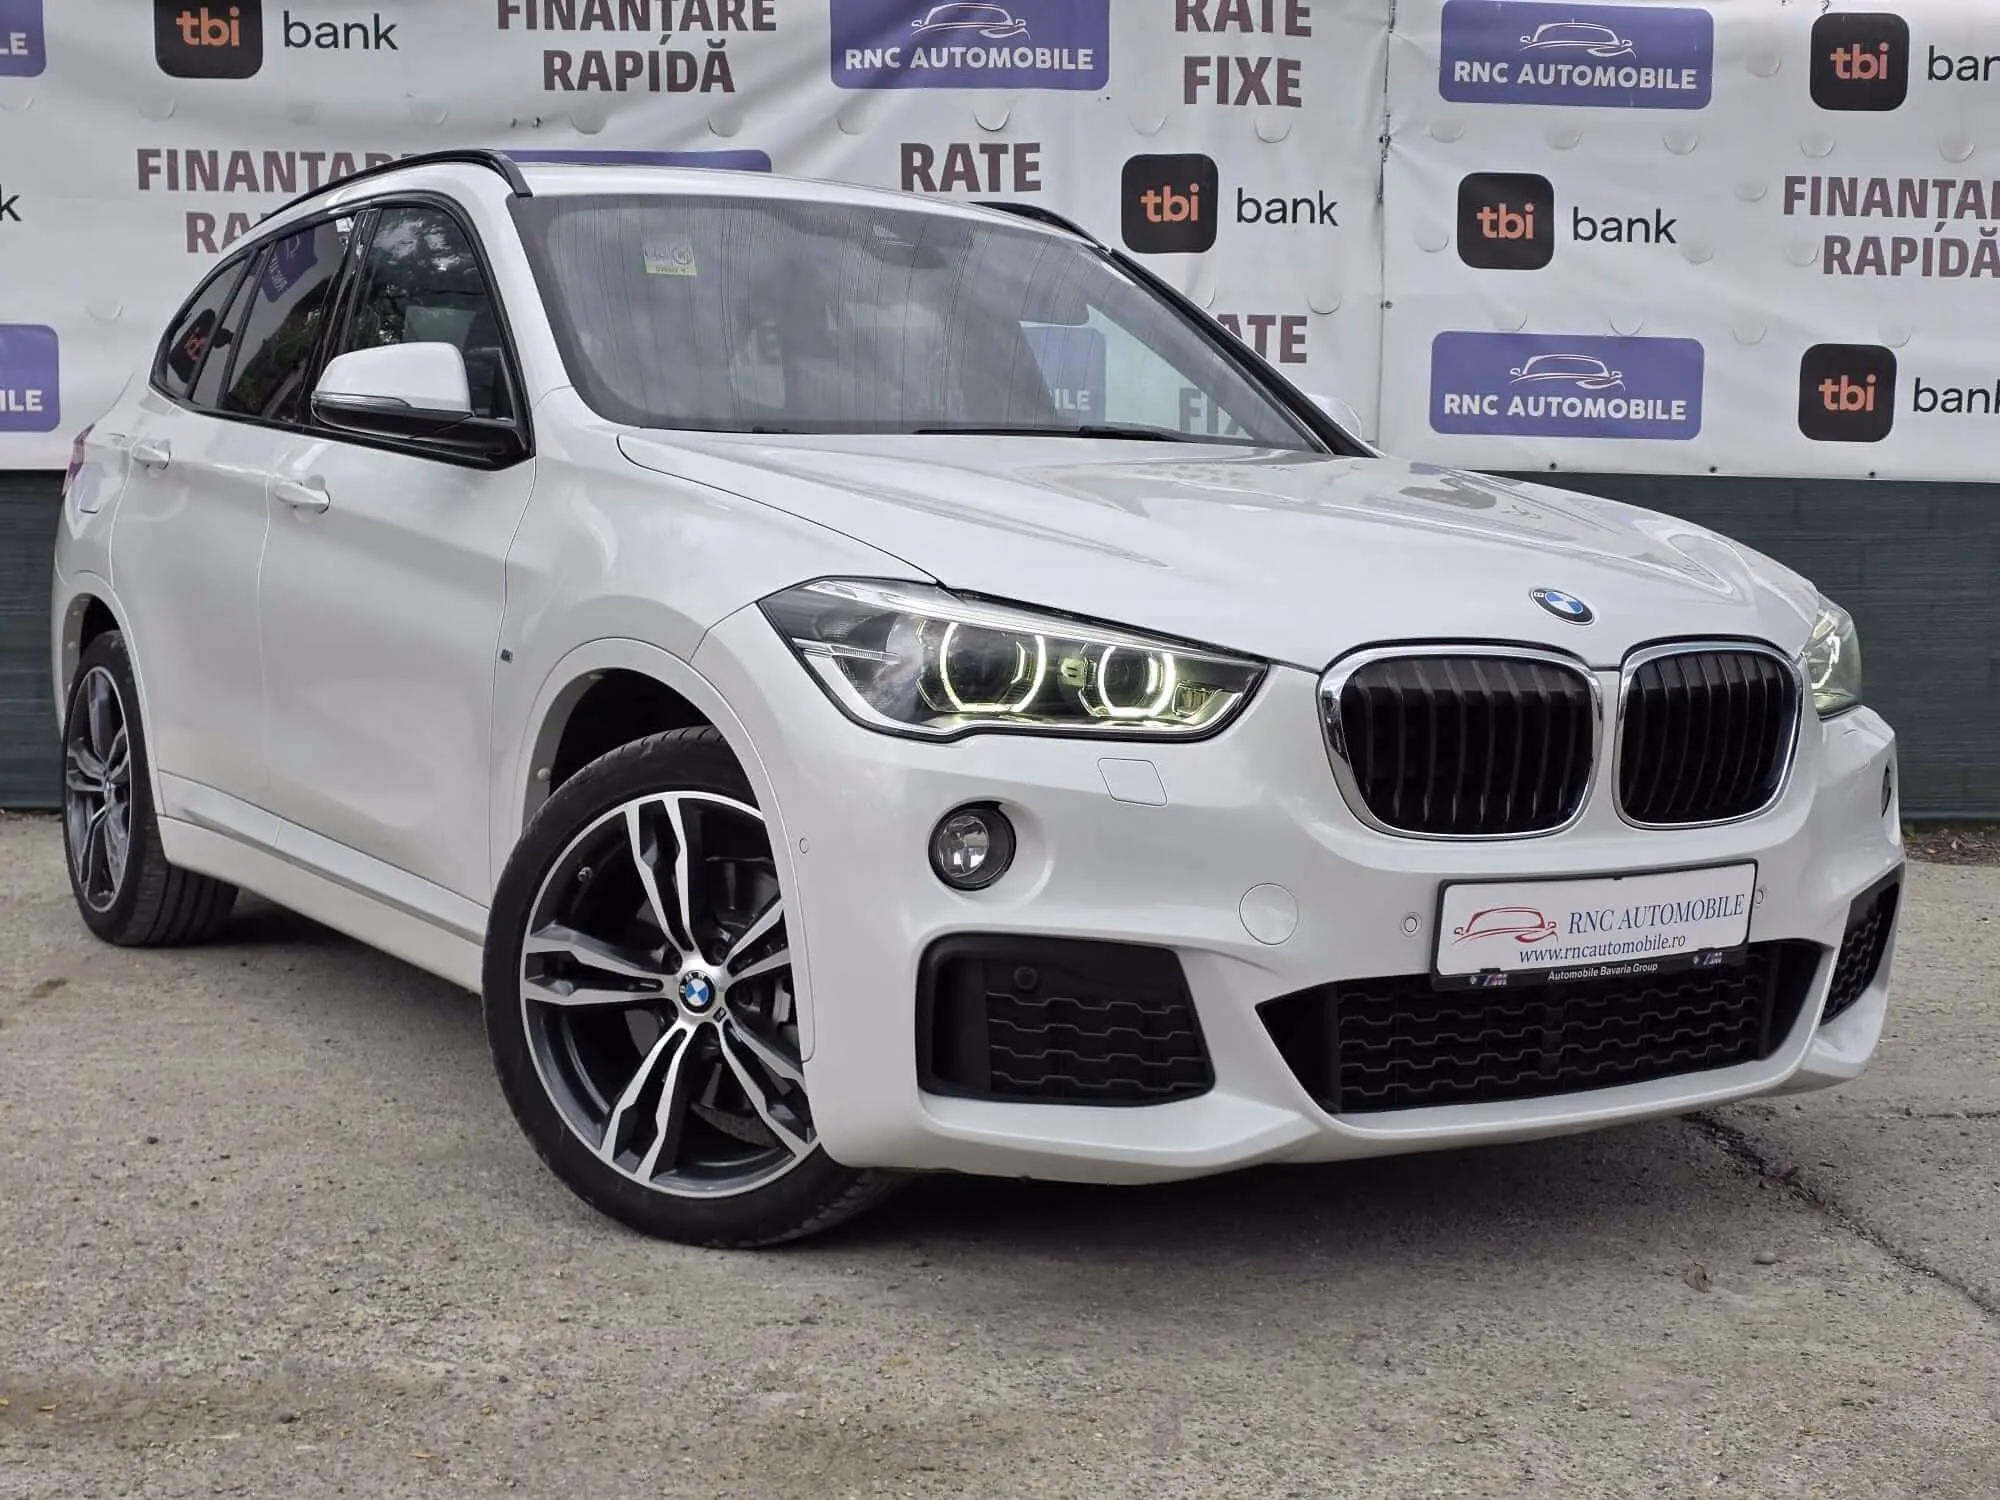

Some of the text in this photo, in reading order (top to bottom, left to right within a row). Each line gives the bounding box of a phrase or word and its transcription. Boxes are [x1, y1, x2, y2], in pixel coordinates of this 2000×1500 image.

[176, 6, 399, 50] tbi bank
[1175, 0, 1312, 37] RATE
[845, 46, 1094, 70] RNC AUTOMOBILE
[1454, 61, 1697, 90] RNC AUTOMOBILE
[1830, 42, 2000, 81] tbi ban
[1184, 56, 1302, 108] FIXE
[901, 142, 1042, 193] RATE
[1140, 183, 1339, 226] tbi bank
[1477, 202, 1678, 244] tbi bank
[1783, 176, 2000, 232] FINANȚA
[1444, 393, 1687, 420] RNC AUTOMOBILE
[1818, 374, 1876, 411] tbi
[1568, 894, 1745, 934] RNC AUTOMOBILE
[1519, 935, 1686, 964] www.rncautomobile.ro
[1548, 961, 1658, 981] Automobile Bavaria Group
